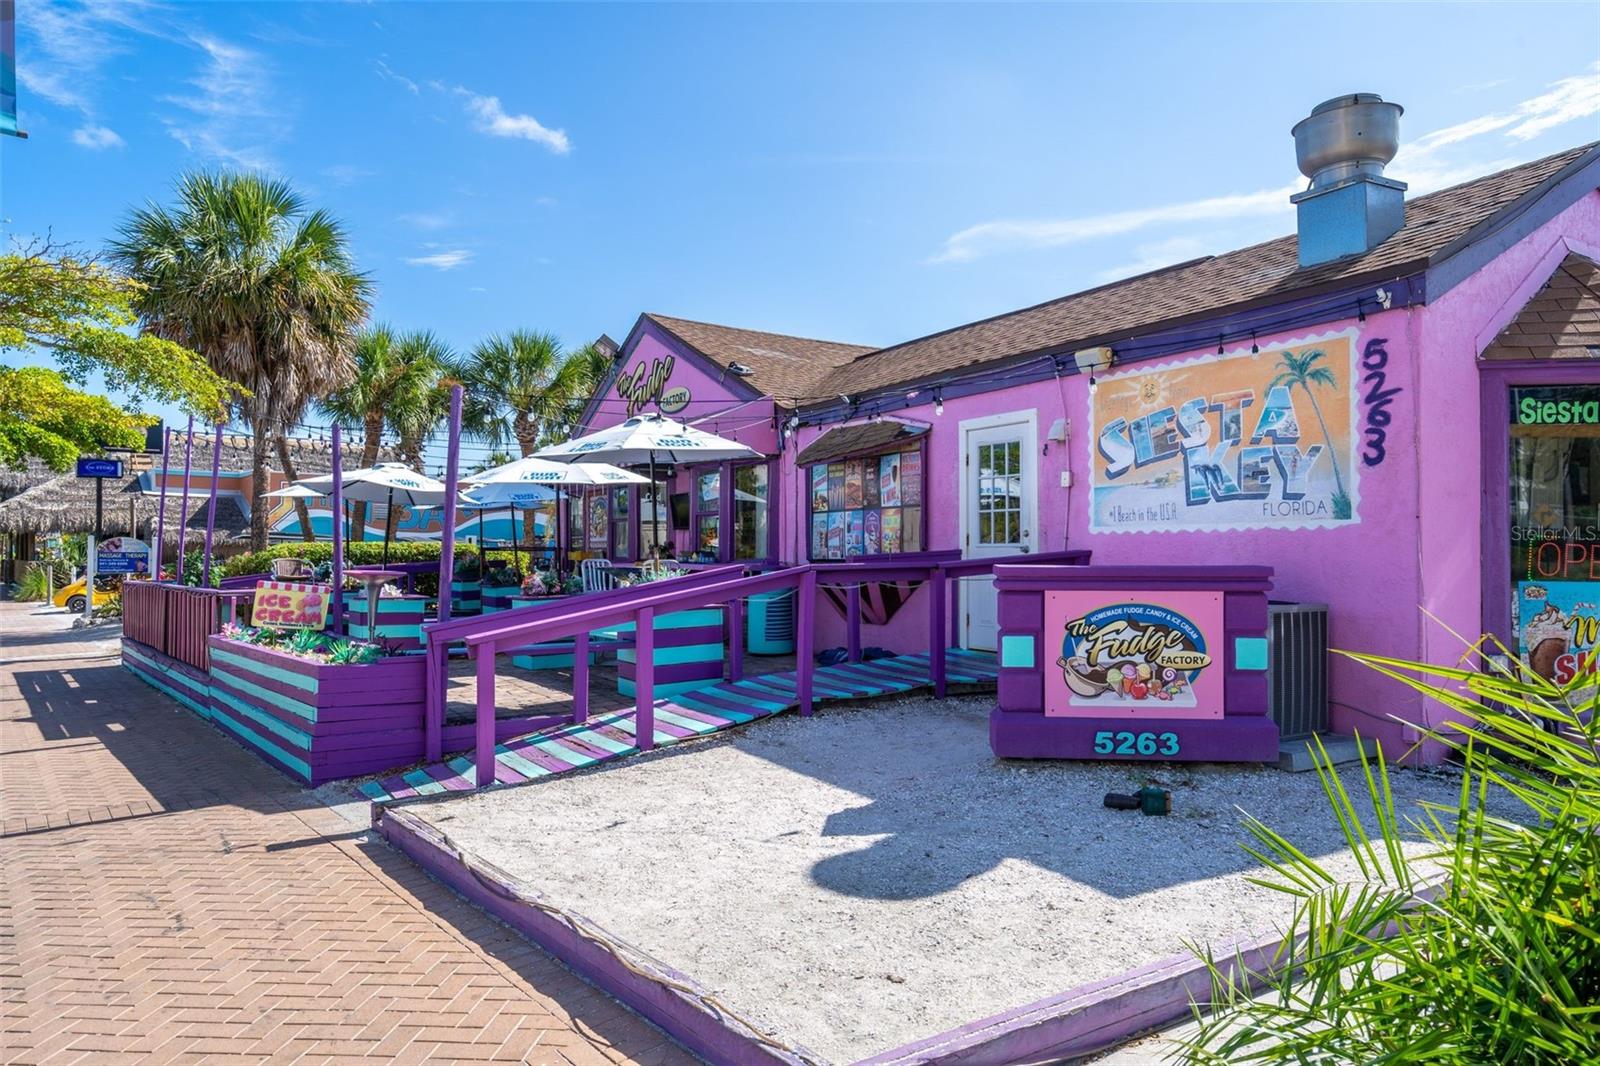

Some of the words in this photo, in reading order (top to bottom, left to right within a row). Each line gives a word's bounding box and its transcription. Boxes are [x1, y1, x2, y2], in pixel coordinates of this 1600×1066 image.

[626, 355, 675, 418] Fudge
[662, 391, 687, 407] FACTORY
[1363, 338, 1402, 466] 5263
[1520, 397, 1599, 424] Siesta
[1098, 386, 1301, 480] SIESTA
[1184, 440, 1324, 506] KEY
[1118, 505, 1136, 522] Beach
[1146, 507, 1157, 521] the
[1263, 500, 1328, 516] FLORIDA
[258, 593, 292, 609] ICE
[255, 608, 322, 625] CREAM
[1090, 608, 1122, 623] HOMEMADE
[1171, 616, 1181, 626] ICE
[1180, 622, 1199, 639] CREAM
[1066, 618, 1098, 636] The
[1088, 620, 1185, 667] Fudge
[1161, 656, 1205, 664] FACTORY
[1094, 731, 1181, 756] 5263
